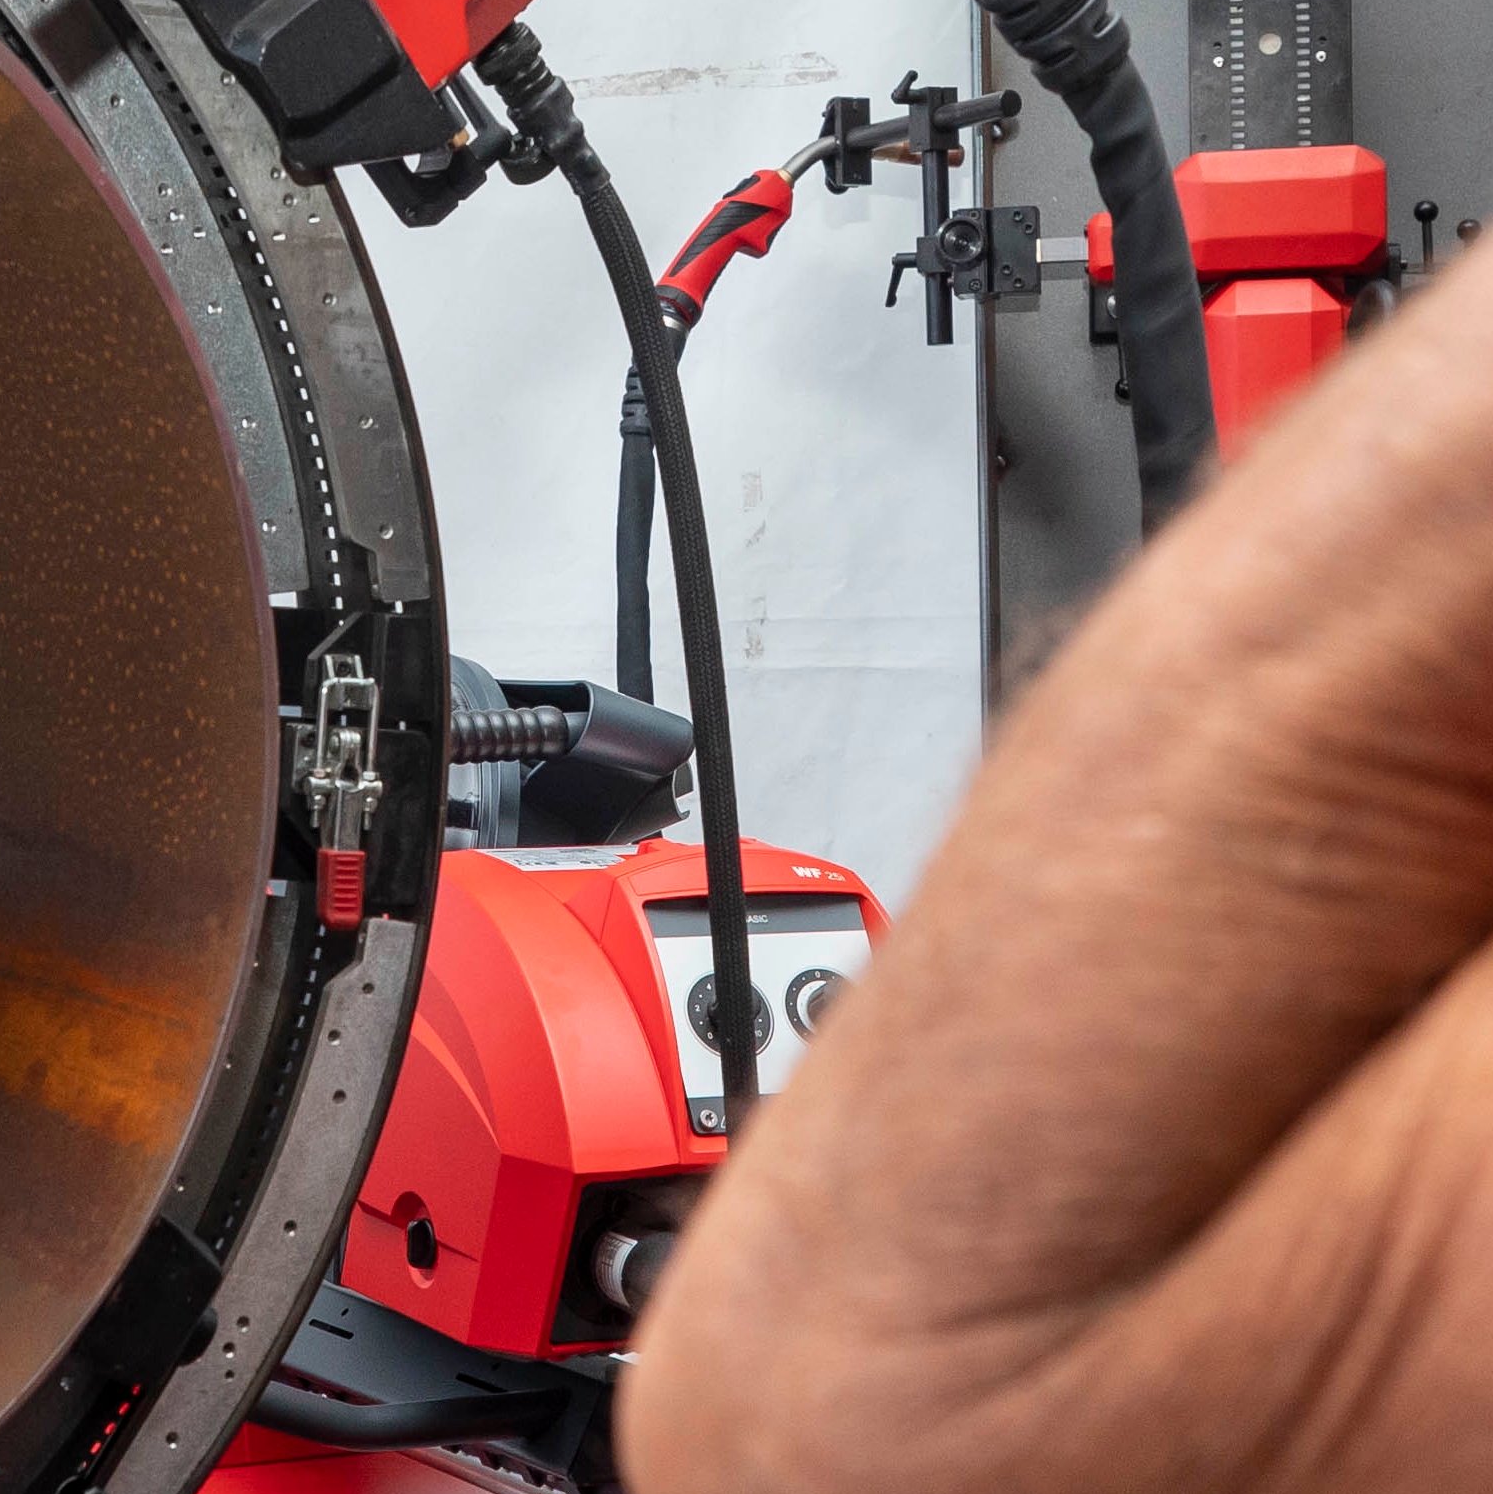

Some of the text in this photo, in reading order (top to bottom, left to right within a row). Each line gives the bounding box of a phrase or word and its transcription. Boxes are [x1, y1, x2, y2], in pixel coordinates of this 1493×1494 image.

[791, 866, 821, 878] WF
[746, 914, 769, 924] ASIC
[706, 983, 712, 991] 4
